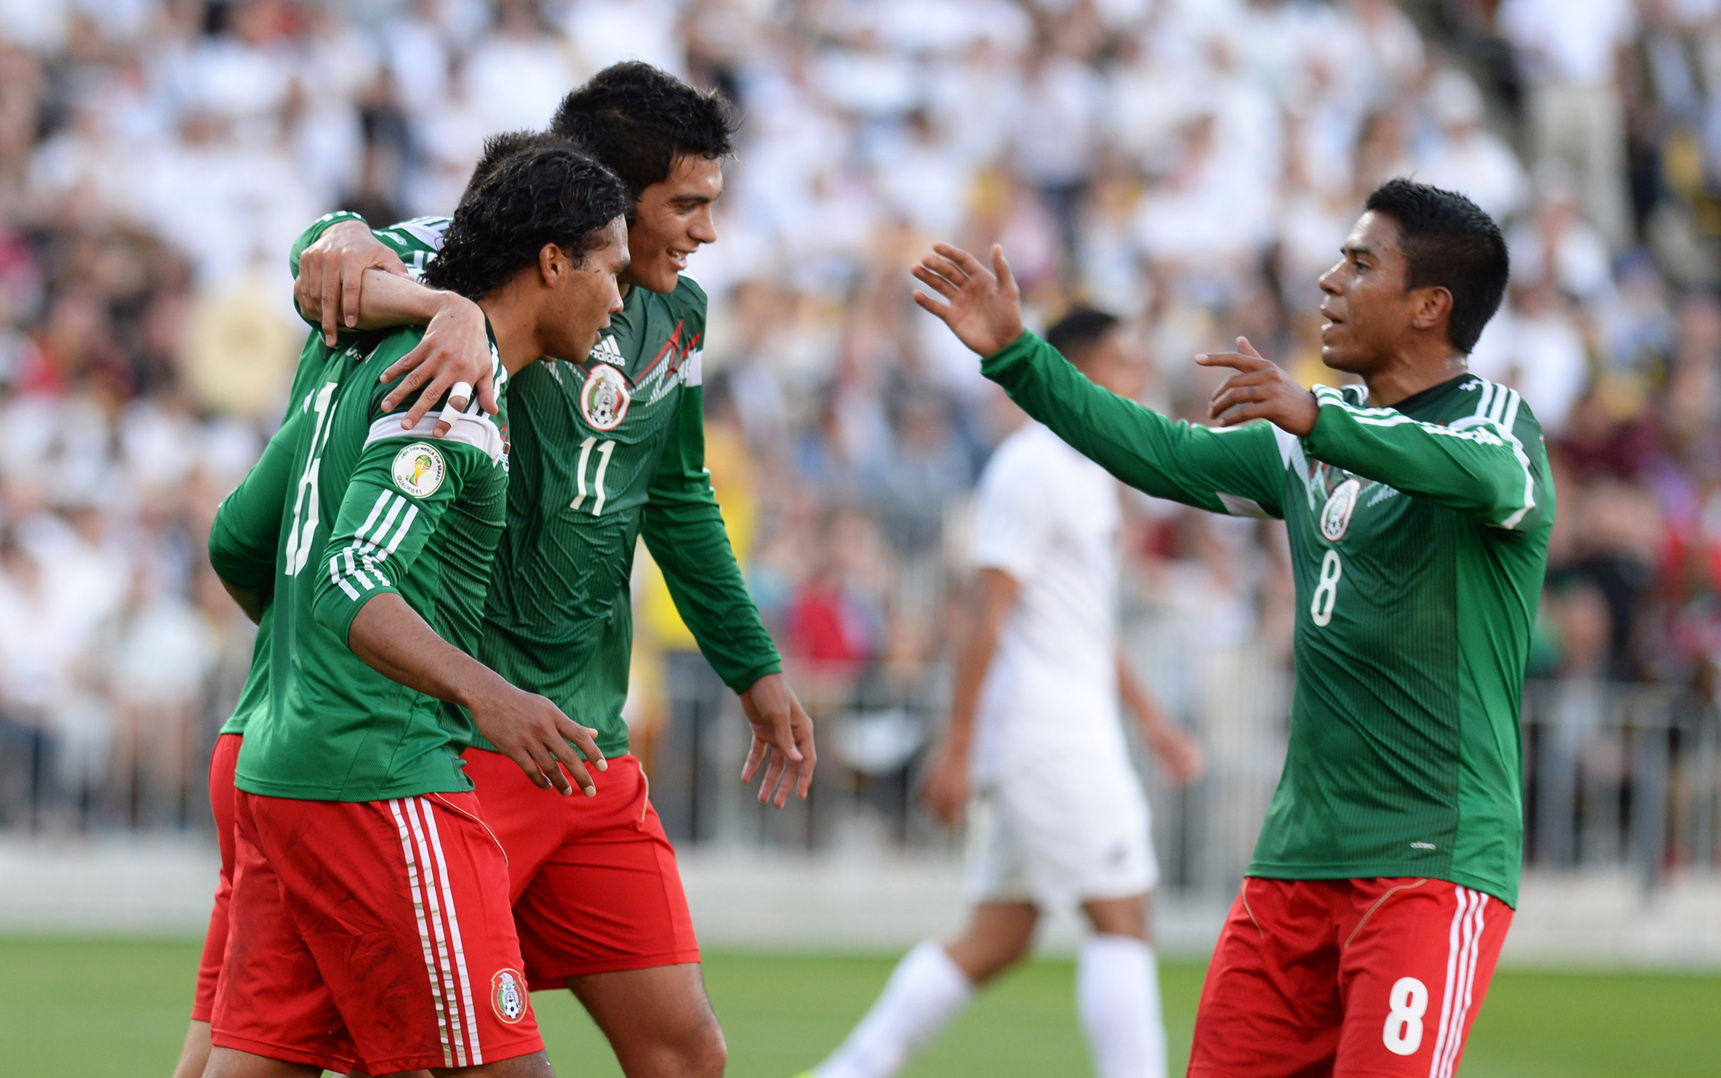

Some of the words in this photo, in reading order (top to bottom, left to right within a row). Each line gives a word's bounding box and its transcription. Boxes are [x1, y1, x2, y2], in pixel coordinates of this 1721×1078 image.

[589, 348, 625, 367] adidas
[569, 435, 617, 517] 11
[1310, 549, 1343, 628] 8
[1382, 976, 1429, 1056] 8
